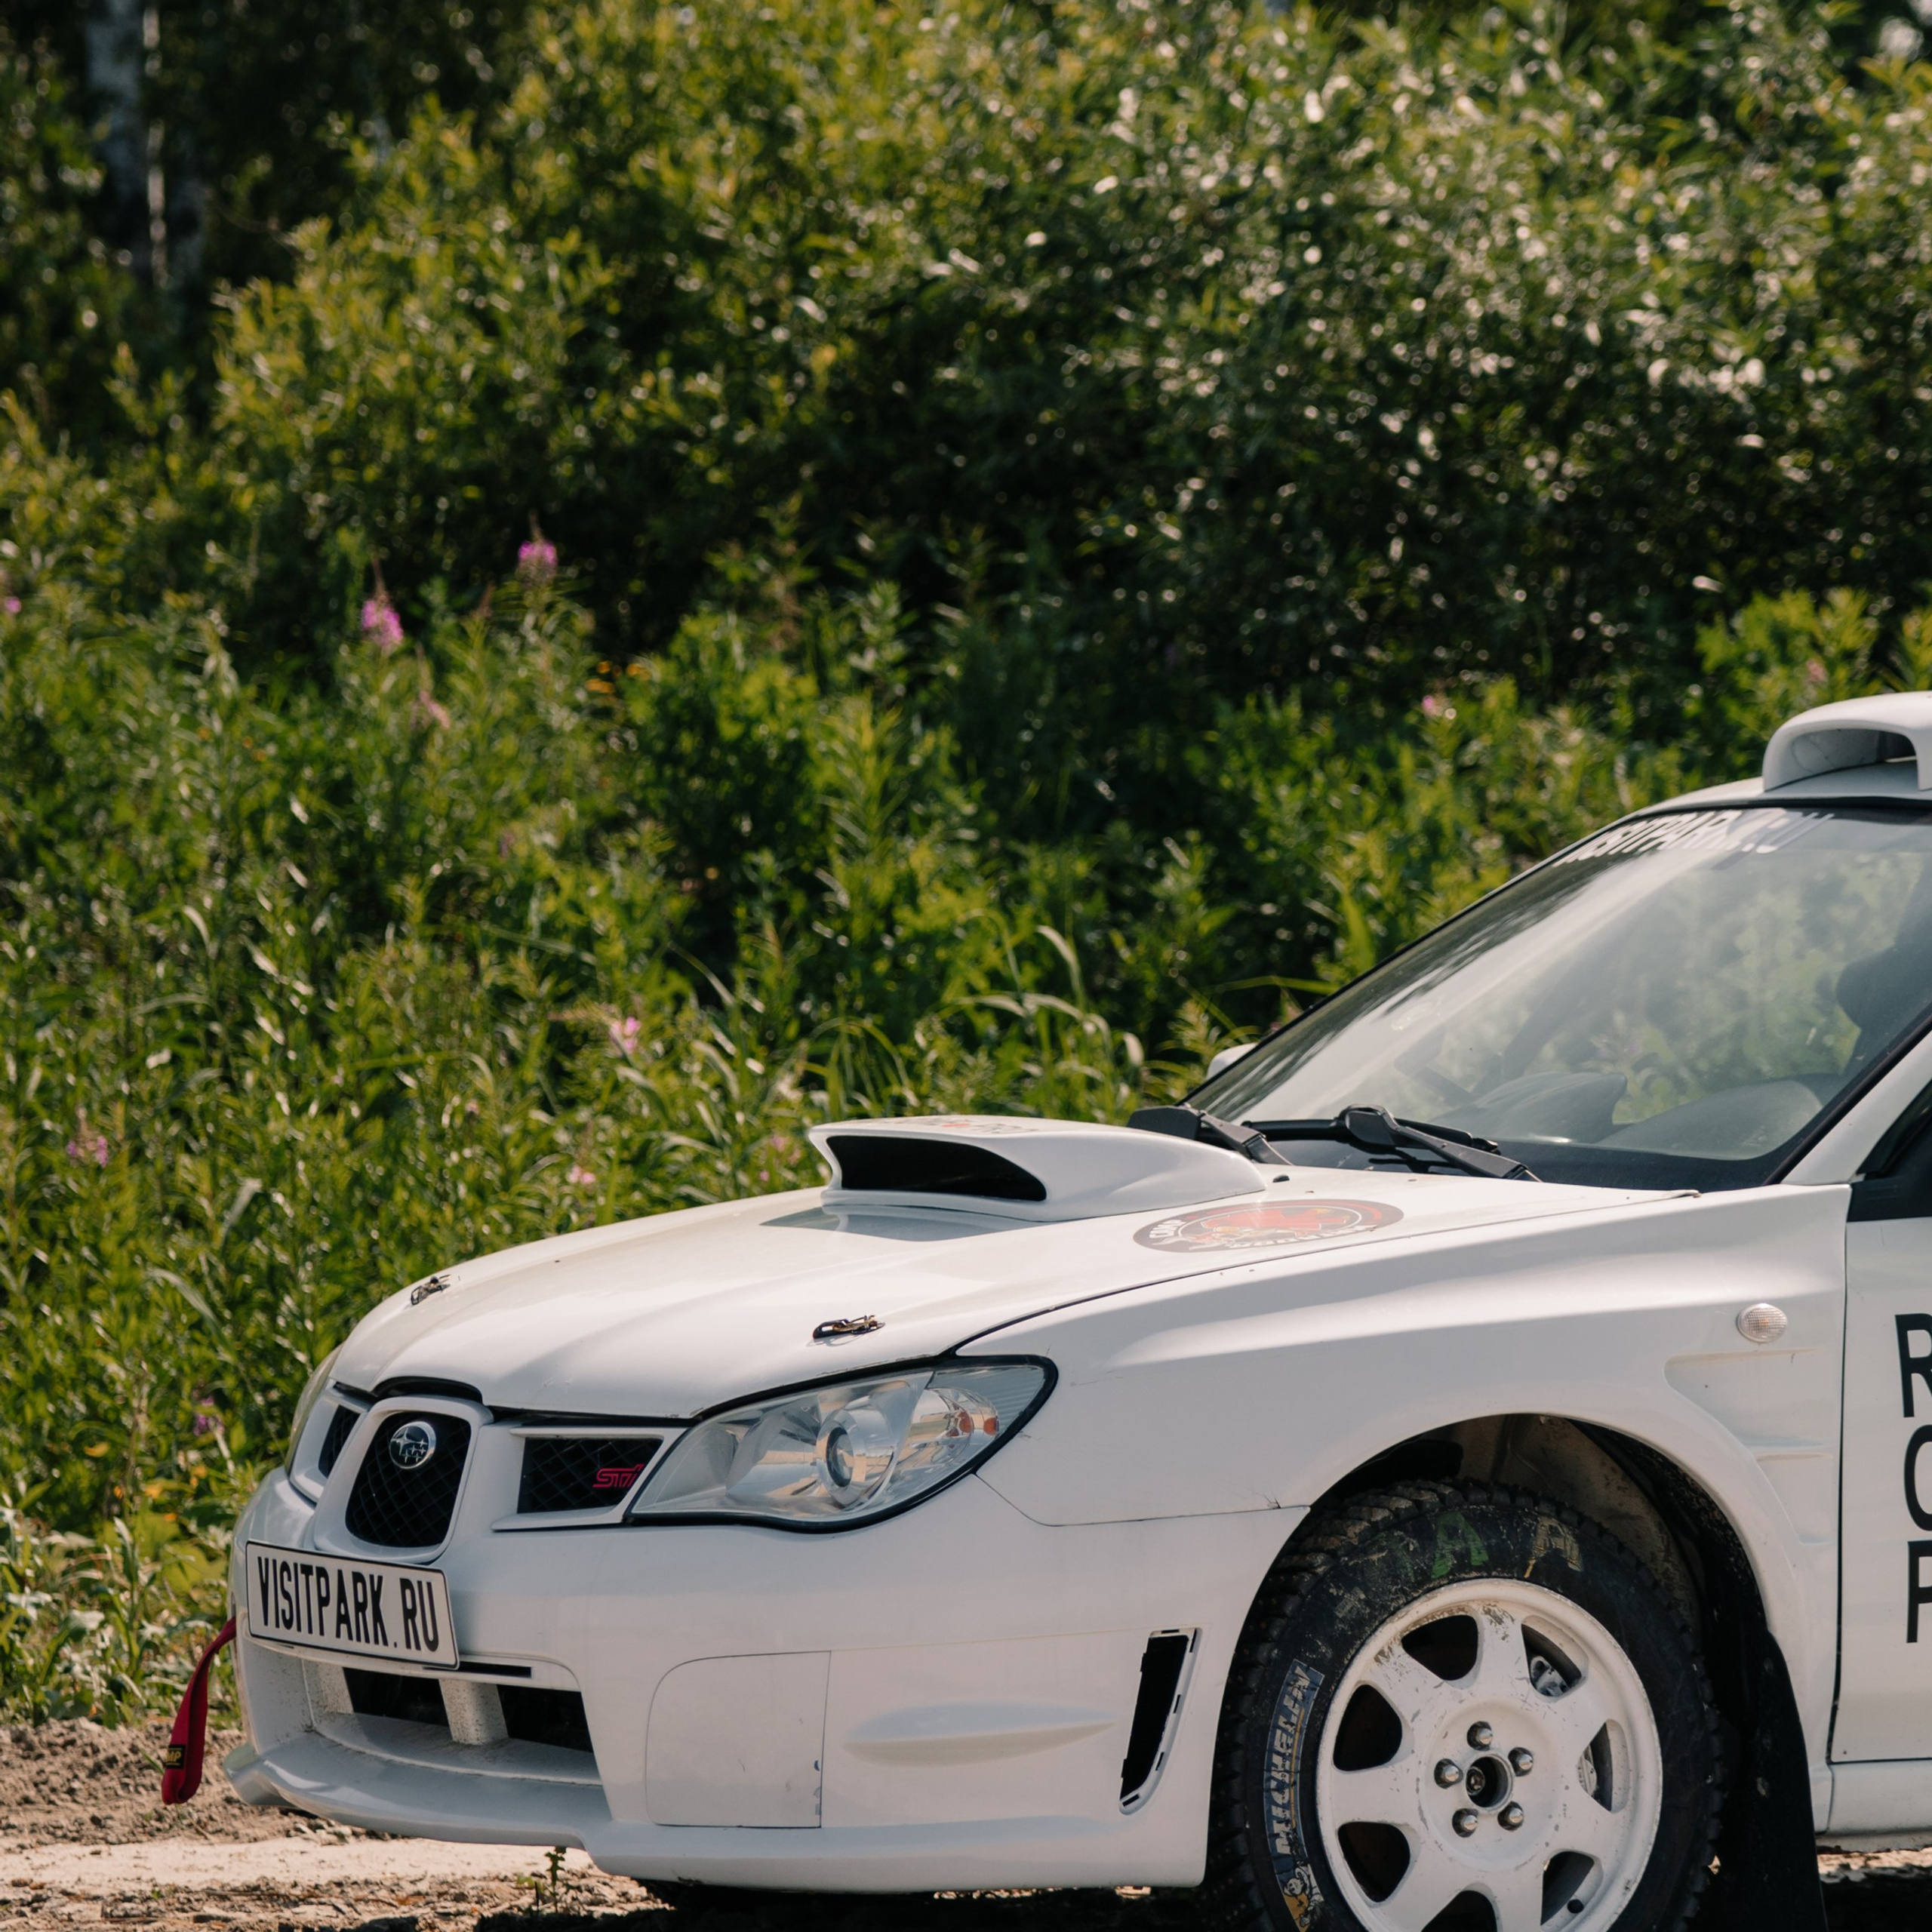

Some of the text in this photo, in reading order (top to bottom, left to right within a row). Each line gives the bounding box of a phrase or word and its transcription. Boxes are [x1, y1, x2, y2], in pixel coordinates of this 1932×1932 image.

[257, 1555, 439, 1652] VISITPARK.RU
[166, 1750, 182, 1763] MP
[1266, 1665, 1314, 1855] MICHELIN
